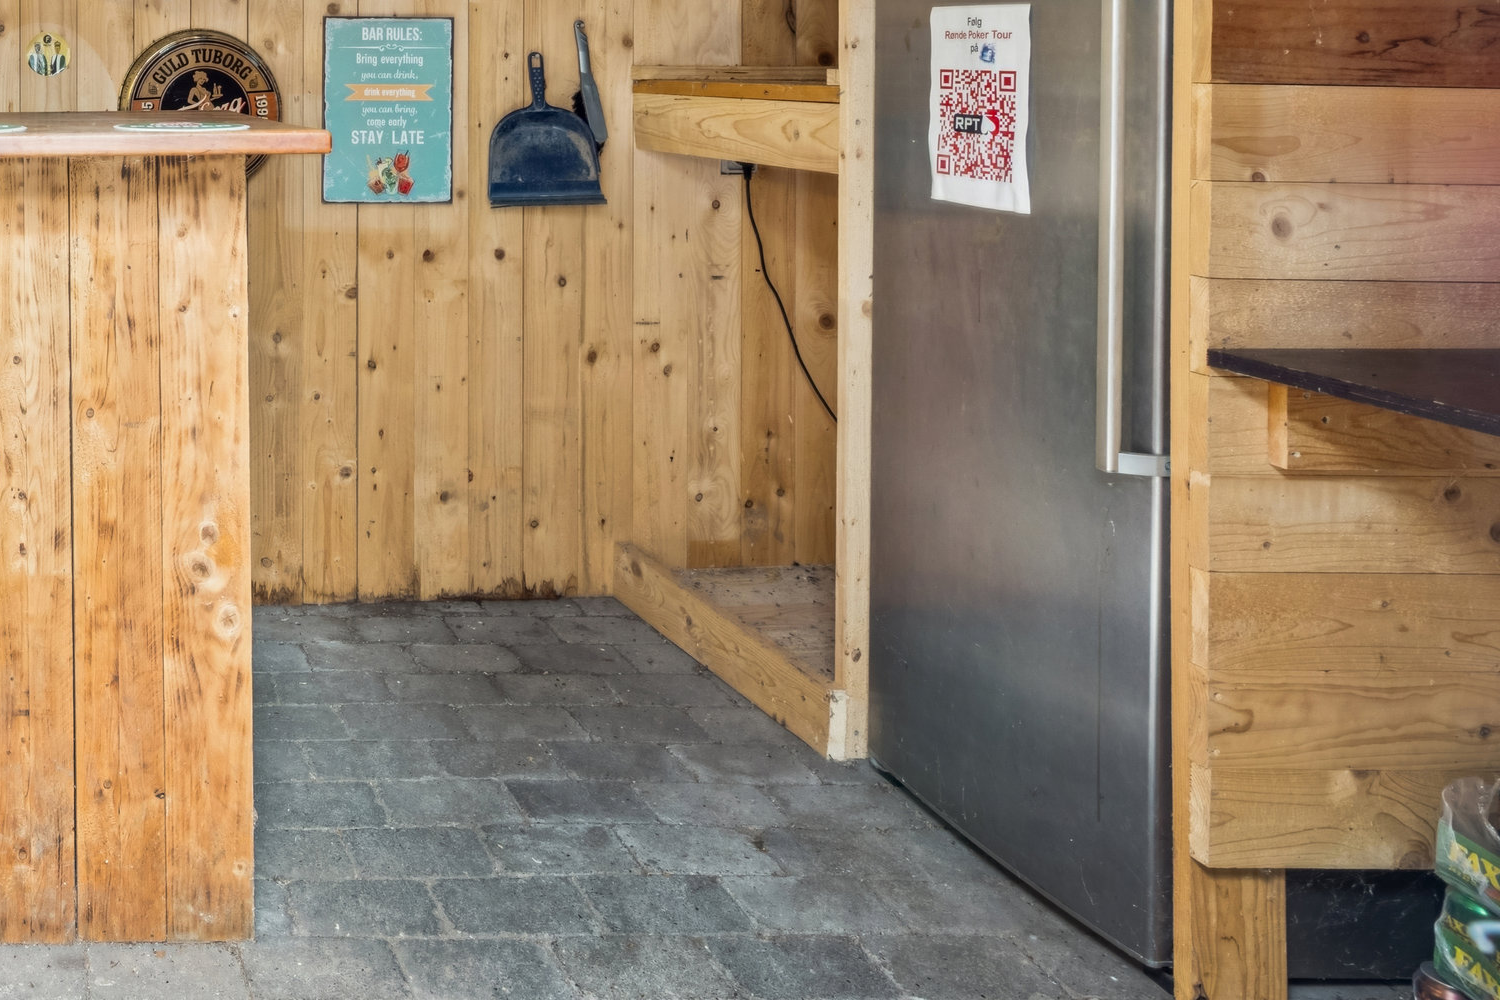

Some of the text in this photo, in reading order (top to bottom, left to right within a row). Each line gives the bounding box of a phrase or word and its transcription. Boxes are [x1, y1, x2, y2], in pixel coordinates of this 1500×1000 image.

[967, 16, 982, 28] Følg
[361, 27, 423, 41] BAR RULES:
[945, 30, 1012, 40] Rønde Poker Tour
[970, 44, 979, 54] på
[152, 48, 253, 85] GULD TUBORG
[356, 53, 423, 67] Bring everything
[360, 71, 376, 82] you
[363, 88, 416, 98] drink everything
[255, 94, 269, 119] 199
[362, 106, 377, 117] you
[366, 115, 407, 128] come early
[954, 116, 981, 131] RPT
[351, 130, 425, 144] STAY LATE
